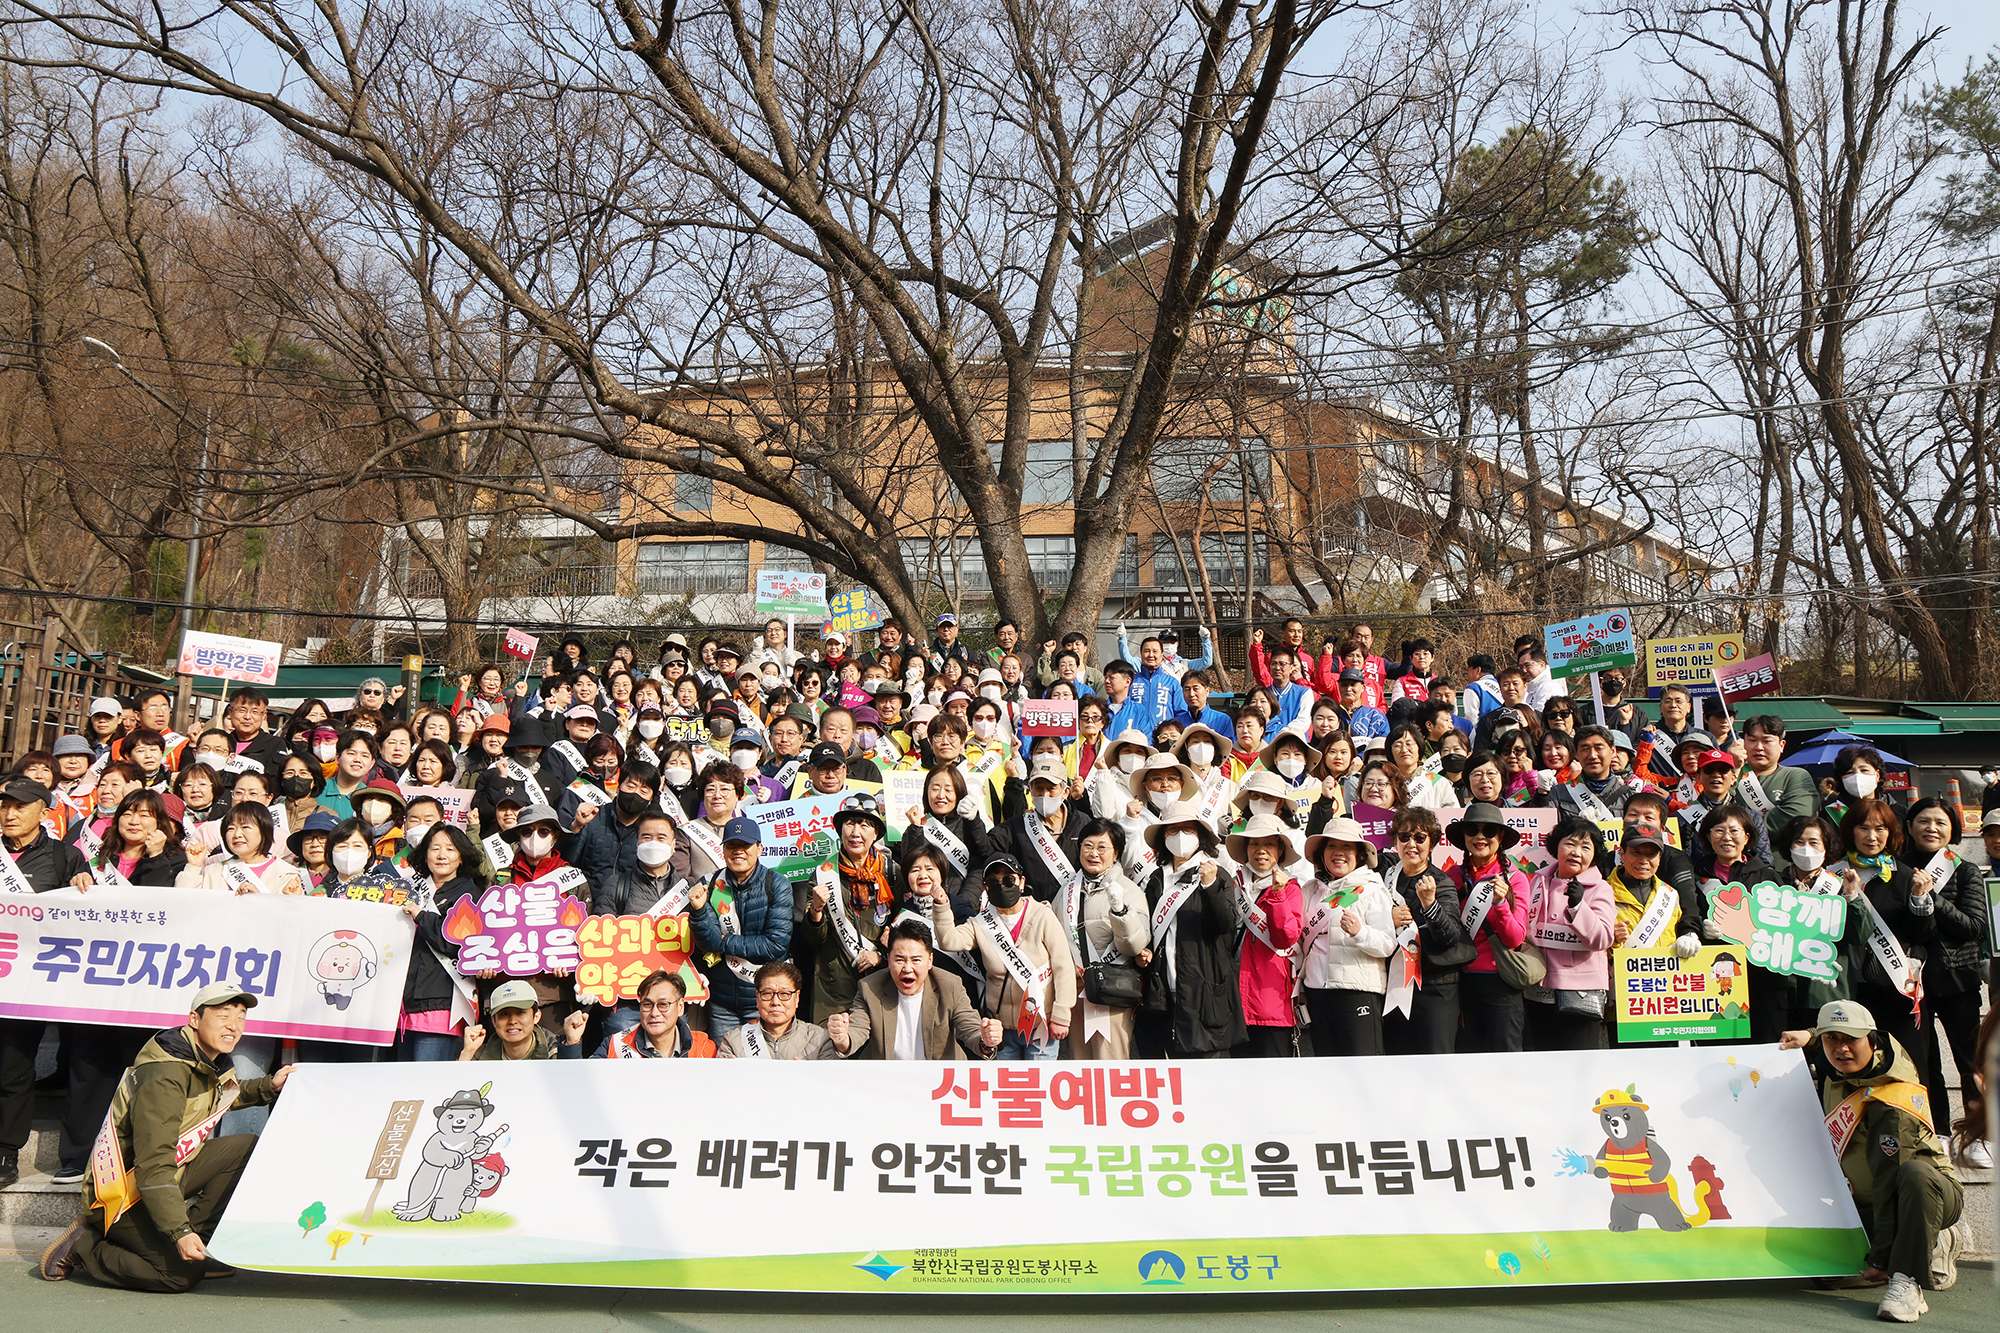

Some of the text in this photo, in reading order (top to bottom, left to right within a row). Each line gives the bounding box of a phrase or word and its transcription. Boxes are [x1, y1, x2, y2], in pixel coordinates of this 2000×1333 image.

[831, 589, 867, 613] 산불
[832, 609, 869, 631] 예방
[1550, 624, 1577, 639] 그만해요
[1562, 628, 1609, 647] 불법 소각!
[1552, 639, 1629, 660] 함께해요 산불 예방!
[1654, 642, 1714, 654] 라이터 소지 금지
[196, 648, 264, 673] 방학2동
[1655, 654, 1714, 668] 선택이 아닌
[1656, 667, 1711, 681] 의무입니다
[1721, 665, 1774, 695] 도봉2동
[1025, 710, 1074, 727] 방학3동
[756, 806, 795, 825] 그만해요
[1506, 817, 1538, 828] 수십 년
[774, 820, 802, 839] 불법
[1361, 819, 1393, 837] 도봉
[803, 839, 832, 858] 산불
[1037, 836, 1058, 862] 한순간
[1521, 832, 1533, 847] 몇
[786, 868, 806, 878] 도봉구
[346, 884, 408, 906] 방학1동
[480, 885, 560, 928] 산불
[1756, 883, 1842, 938] 함께
[48, 907, 167, 926] 같이 변화, 행복한 도봉
[579, 917, 690, 957] 산과의
[1534, 928, 1583, 946] 치협의회
[461, 927, 578, 972] 조심은
[994, 931, 1032, 985] 주민자치협
[1750, 928, 1834, 977] 해요
[32, 936, 282, 997] 주민자치회
[1626, 955, 1680, 973] 여러분이
[1627, 973, 1706, 993] 도봉산 산불
[1627, 996, 1721, 1017] 감시원입니다
[1652, 1025, 1717, 1036] 도봉구 주민자치협의회
[931, 1066, 1185, 1129] 산불예방!
[373, 1104, 415, 1177] 산불조심
[573, 1136, 1536, 1198] 작은 배려가 안전한 국립공원을 만듭니다!
[914, 1247, 957, 1258] 국립공원공단
[911, 1258, 1099, 1277] 북한산국립공원도봉사무소
[1196, 1254, 1282, 1281] 도봉구
[912, 1276, 1072, 1285] BUKHANSAN NATIONAL PARK DOBONG OFFICE
